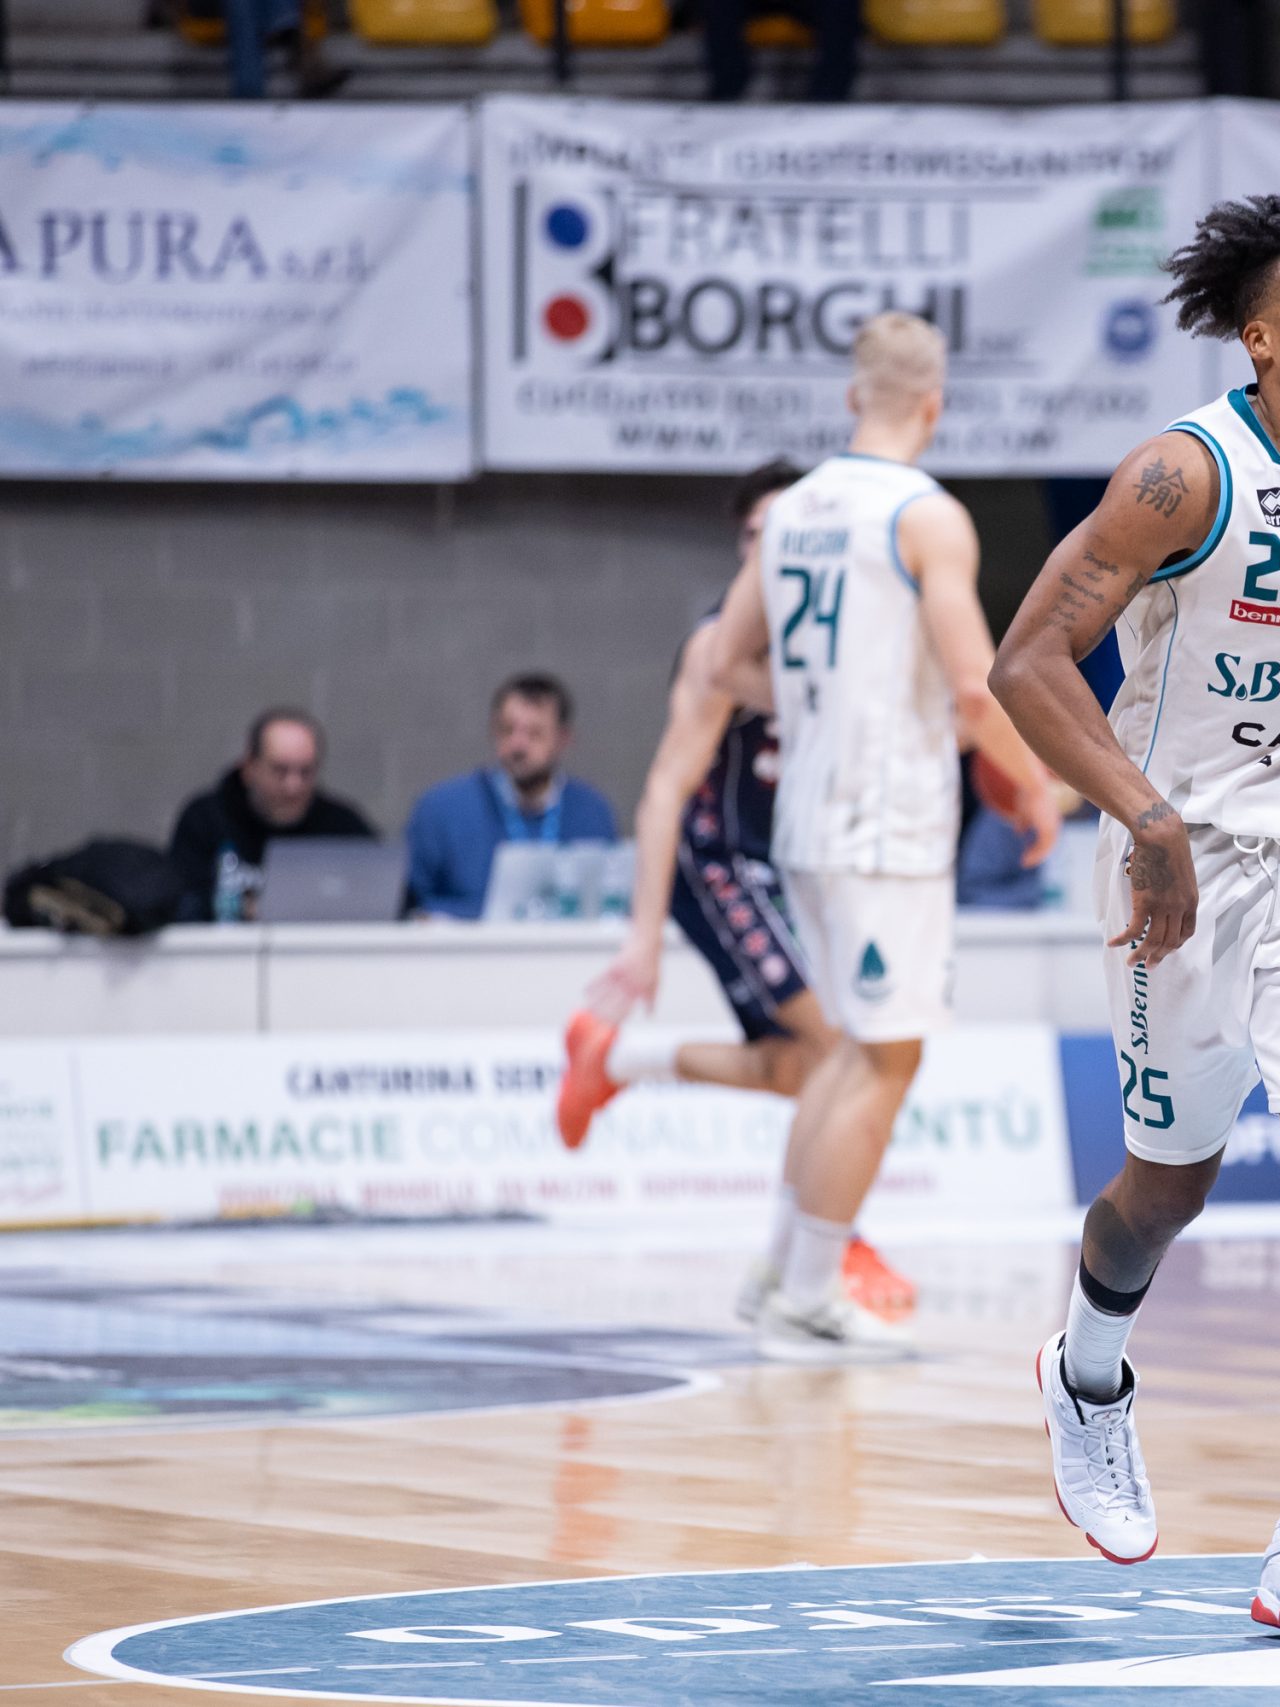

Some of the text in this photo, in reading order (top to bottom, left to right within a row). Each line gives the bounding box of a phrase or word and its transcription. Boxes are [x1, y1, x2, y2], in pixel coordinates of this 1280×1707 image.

[628, 200, 970, 268] FRATELLI
[627, 279, 966, 356] BORGHI
[778, 566, 847, 670] 24
[1120, 1050, 1175, 1129] 25
[98, 1116, 402, 1167] FARMACIE
